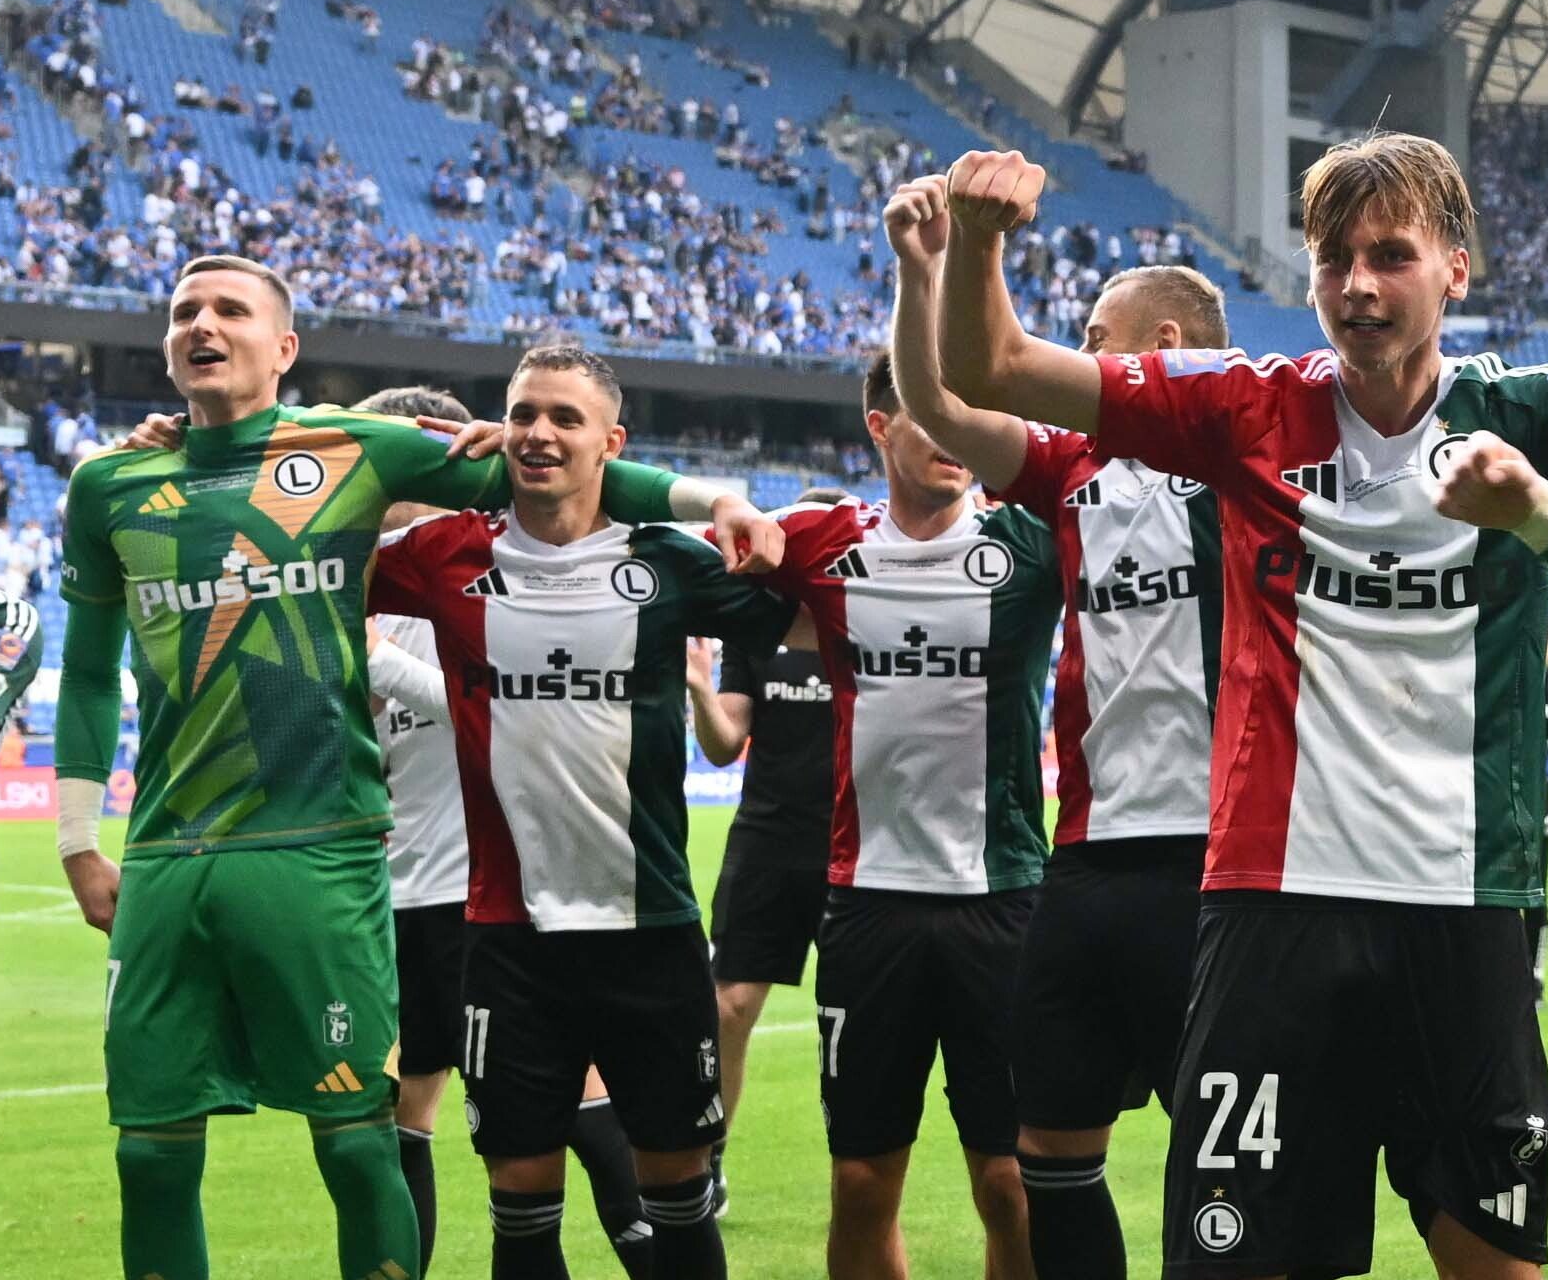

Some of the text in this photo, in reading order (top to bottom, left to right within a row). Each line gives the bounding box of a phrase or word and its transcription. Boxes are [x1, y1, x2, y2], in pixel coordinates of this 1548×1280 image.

[137, 557, 345, 617] Plus500
[1256, 545, 1480, 610] Plus50
[461, 665, 634, 703] Plus50
[764, 680, 833, 702] Plus5
[1196, 1071, 1281, 1170] 24
